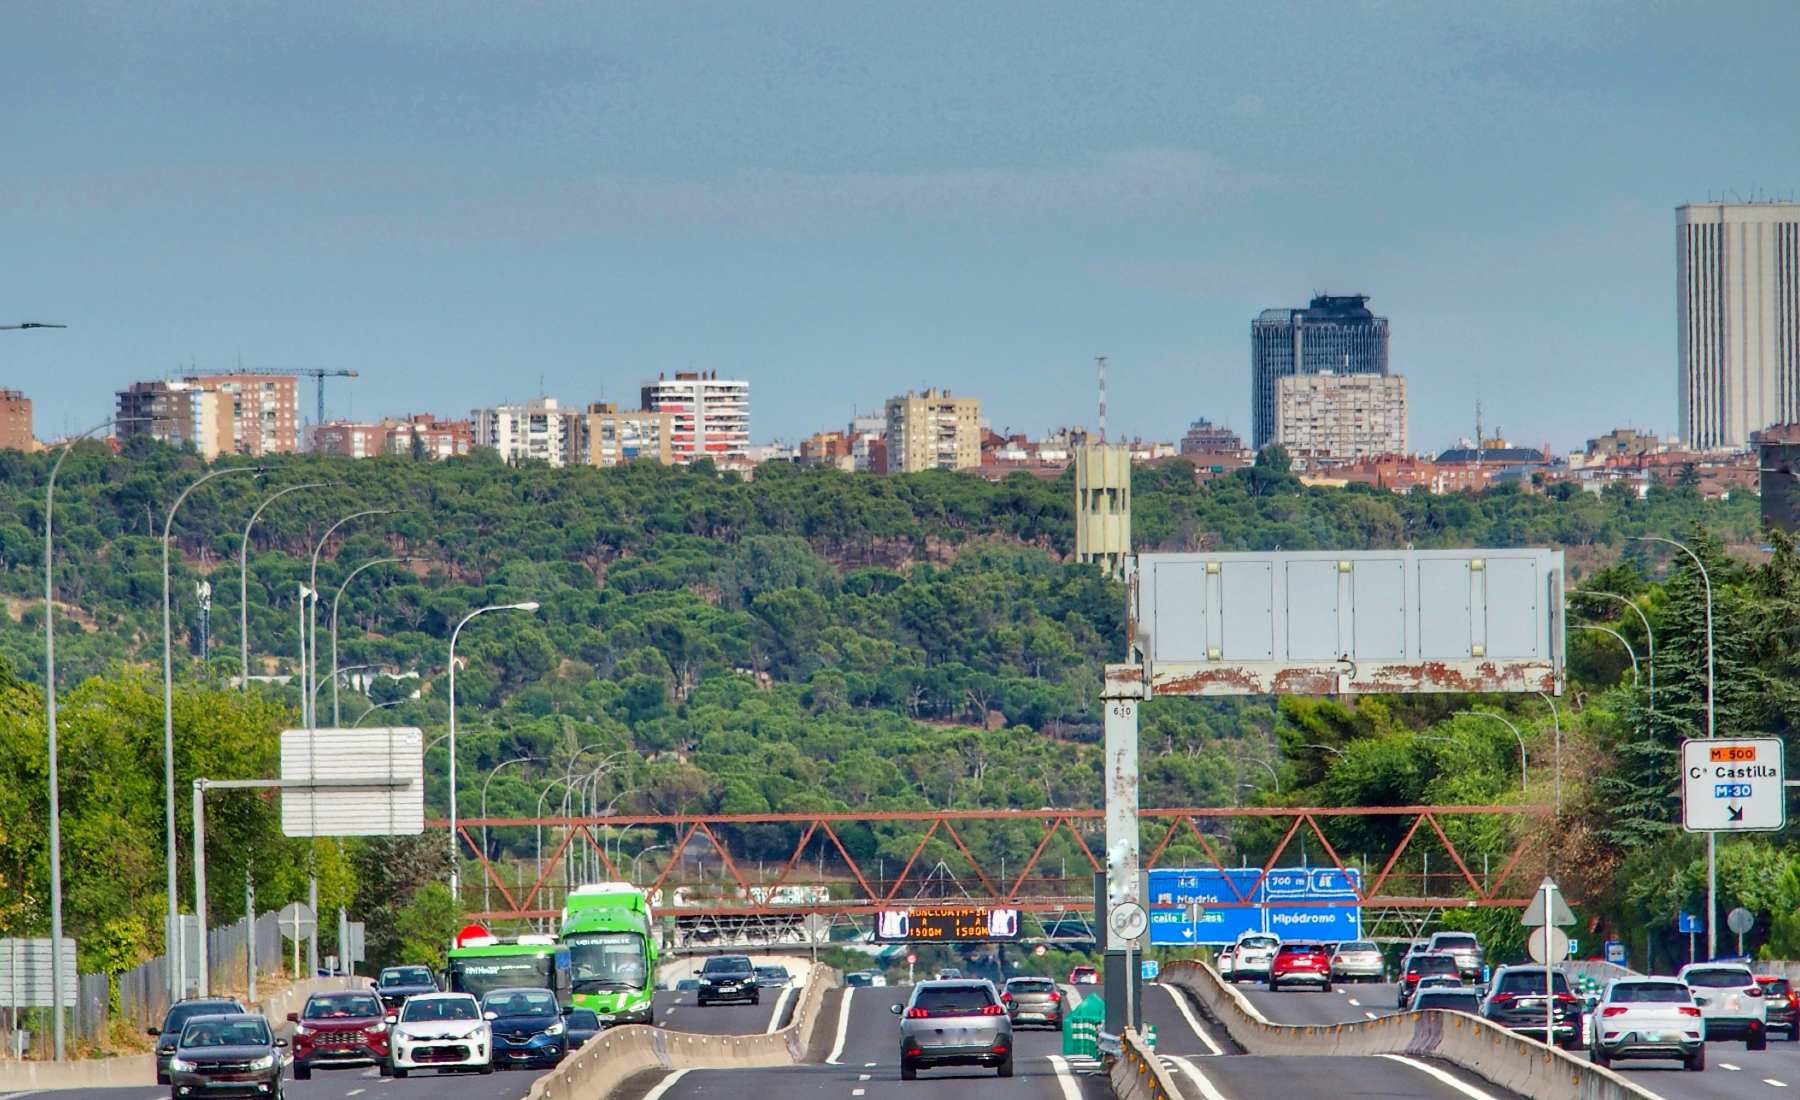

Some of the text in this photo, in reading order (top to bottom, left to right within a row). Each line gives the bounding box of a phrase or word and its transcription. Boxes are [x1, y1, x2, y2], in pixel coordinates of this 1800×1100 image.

[1715, 766, 1776, 778] Castilla
[1716, 786, 1751, 797] M-30
[1177, 894, 1217, 903] Madrid
[1115, 912, 1142, 928] 60
[1272, 912, 1336, 926] Hipódromo
